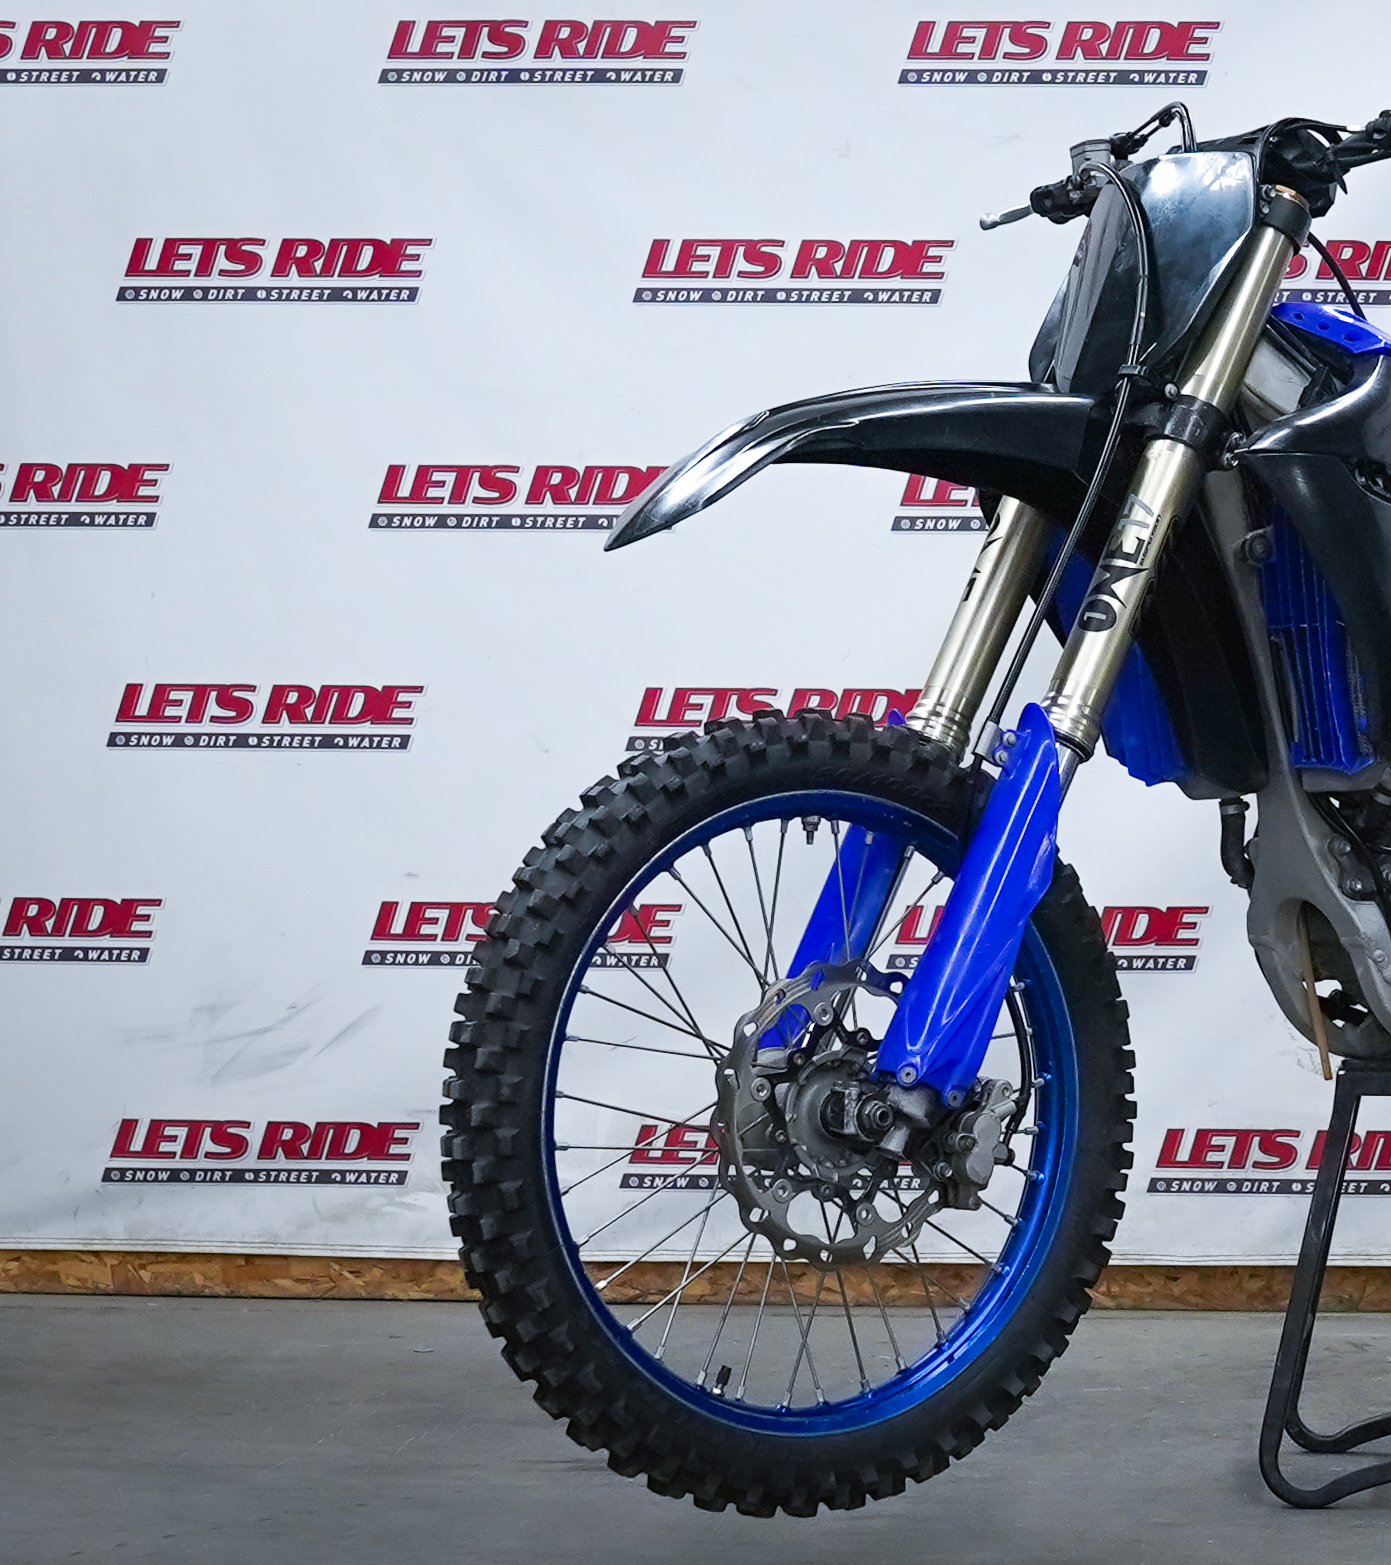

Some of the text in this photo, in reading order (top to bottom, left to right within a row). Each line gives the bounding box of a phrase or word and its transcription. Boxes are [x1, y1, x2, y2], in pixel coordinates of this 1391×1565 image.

[20, 20, 182, 60] RIDE
[386, 19, 698, 60] LETS RIDE
[905, 20, 1222, 61] LETS RIDE
[18, 70, 159, 83] STREET WATER
[400, 70, 675, 83] SNOW DIRT STREET WATER
[920, 71, 1199, 85] SNOW DIRT STREET WATER
[123, 237, 433, 278] LETS RIDE
[640, 238, 955, 280] LETS RIDE
[137, 288, 411, 302] SNOW DIRT STREET WATER
[655, 289, 933, 303] SNOW DIRT STREET WATER
[8, 462, 171, 503] RIDE
[375, 464, 522, 505] LETS
[7, 513, 148, 527] STREET WATER
[390, 515, 588, 529] SNOW DIRT STREET
[913, 518, 963, 531] SNOW
[113, 683, 426, 725] LETS RIDE
[128, 734, 402, 749] SNOW DIRT STREET WATER
[2, 897, 163, 938] RIDE
[1100, 905, 1209, 946] IDE
[1, 949, 141, 962] STREET WATER
[384, 952, 433, 965] SNOW
[1131, 957, 1188, 970] WATER
[108, 1119, 423, 1161] LETS RIDE
[1154, 1128, 1302, 1169] LETS
[123, 1169, 400, 1185] SNOW DIRT STREET WATER
[1169, 1180, 1219, 1193] SNOW
[1241, 1180, 1283, 1193] DIRT
